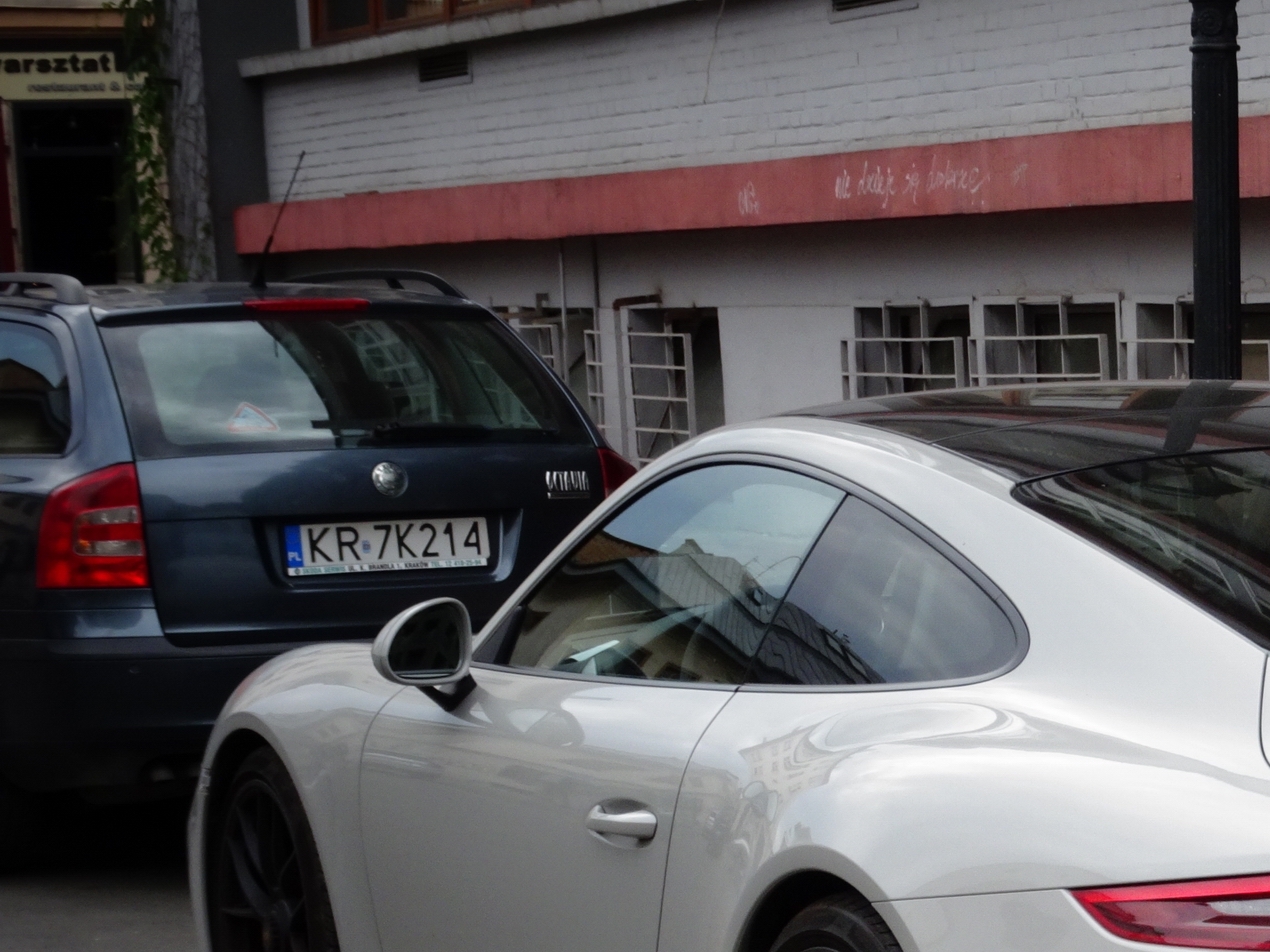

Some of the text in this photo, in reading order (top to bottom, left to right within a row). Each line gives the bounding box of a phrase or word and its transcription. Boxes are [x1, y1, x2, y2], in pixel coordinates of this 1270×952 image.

[0, 53, 110, 73] arsztat
[110, 81, 121, 92] &
[307, 522, 482, 563] KR 7K214
[288, 552, 302, 562] PL
